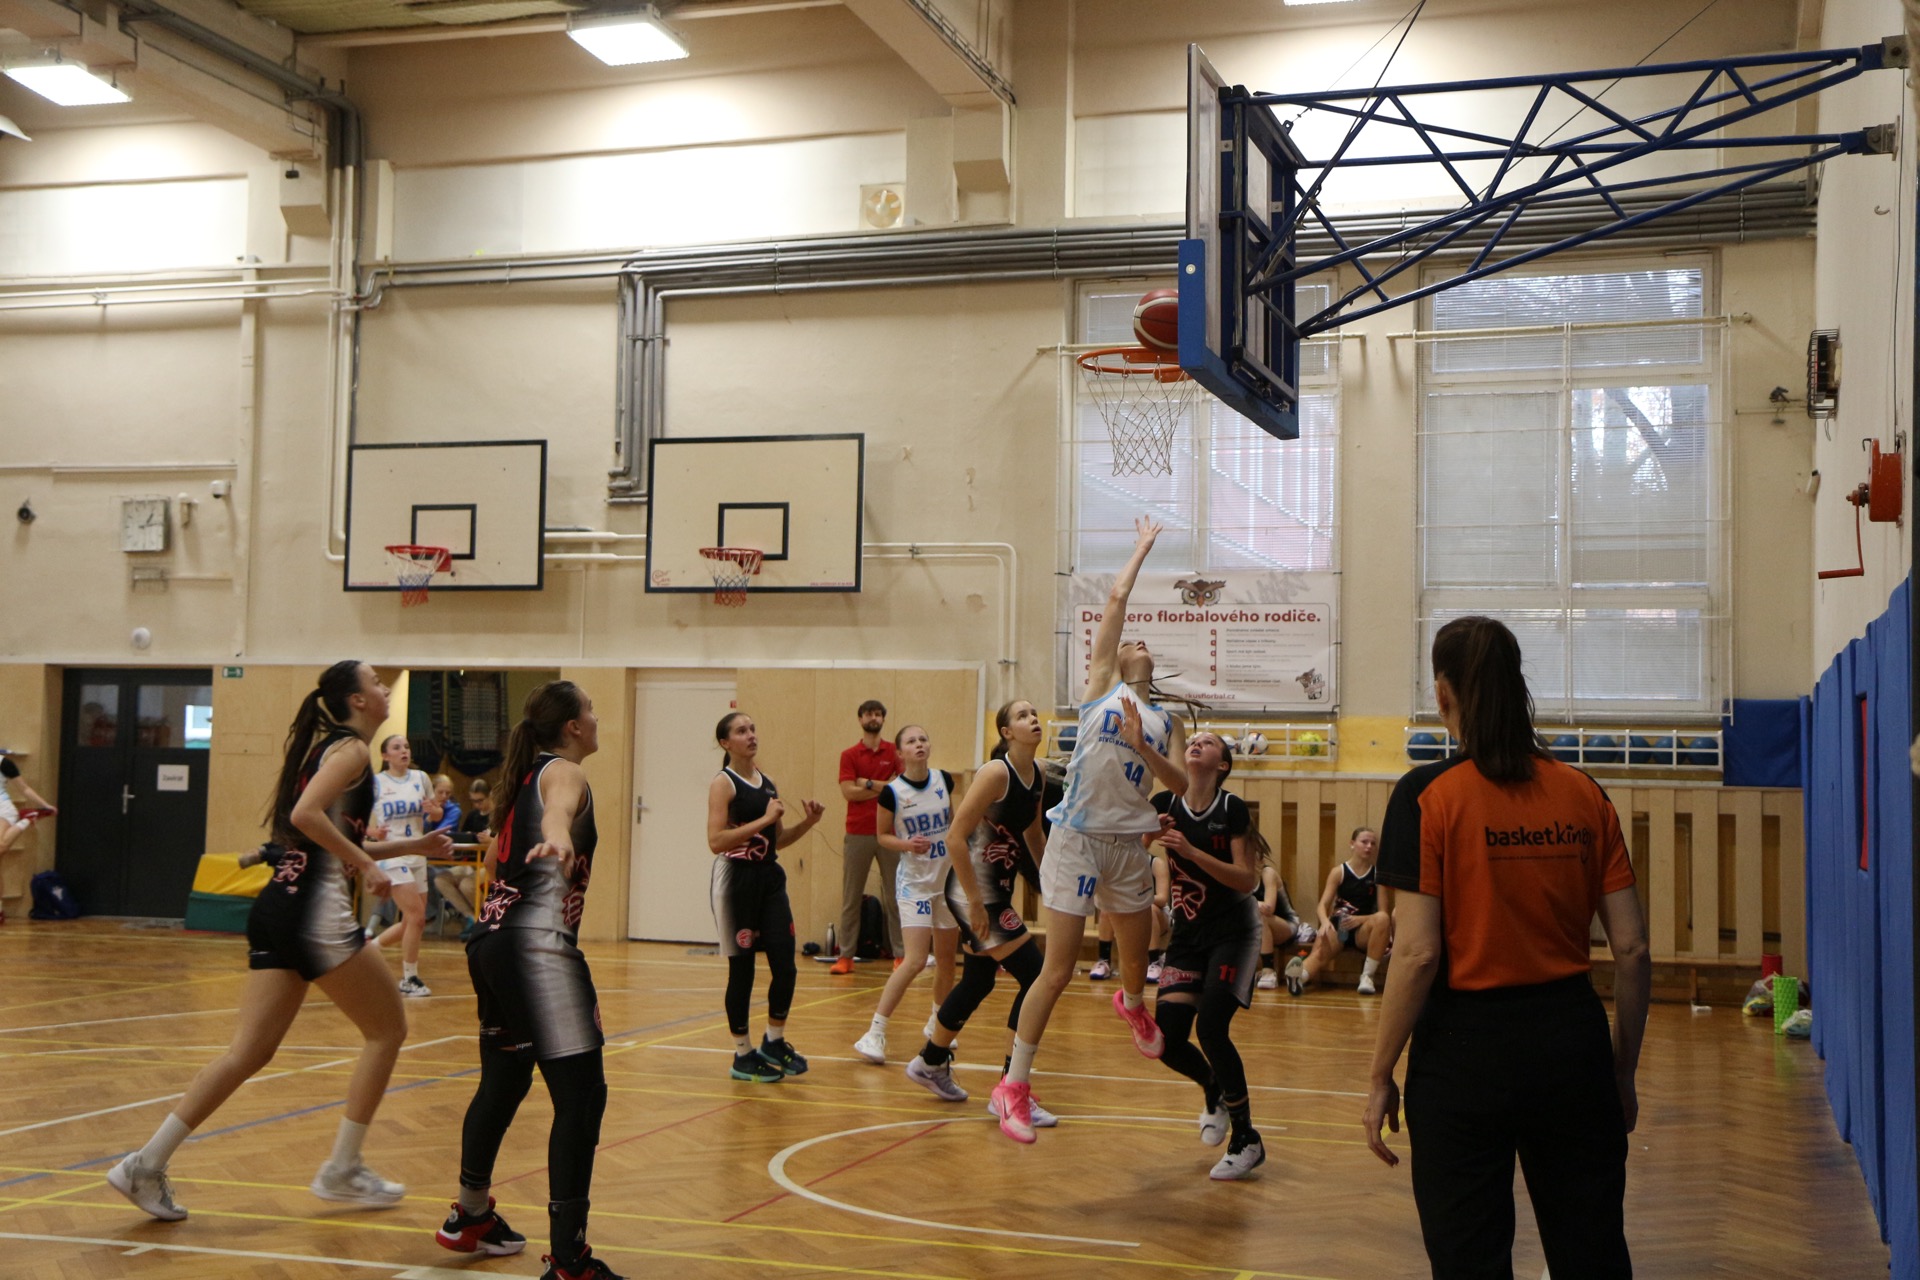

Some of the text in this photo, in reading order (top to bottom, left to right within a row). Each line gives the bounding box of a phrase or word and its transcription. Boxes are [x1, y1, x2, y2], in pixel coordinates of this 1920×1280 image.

[1082, 608, 1321, 623] Deero florbalového rodiče.
[1124, 761, 1145, 787] 14
[405, 824, 412, 837] 6
[930, 840, 946, 859] 26
[1211, 835, 1226, 849] 11
[1077, 875, 1097, 899] 14
[916, 900, 931, 915] 26
[1219, 965, 1237, 984] 11
